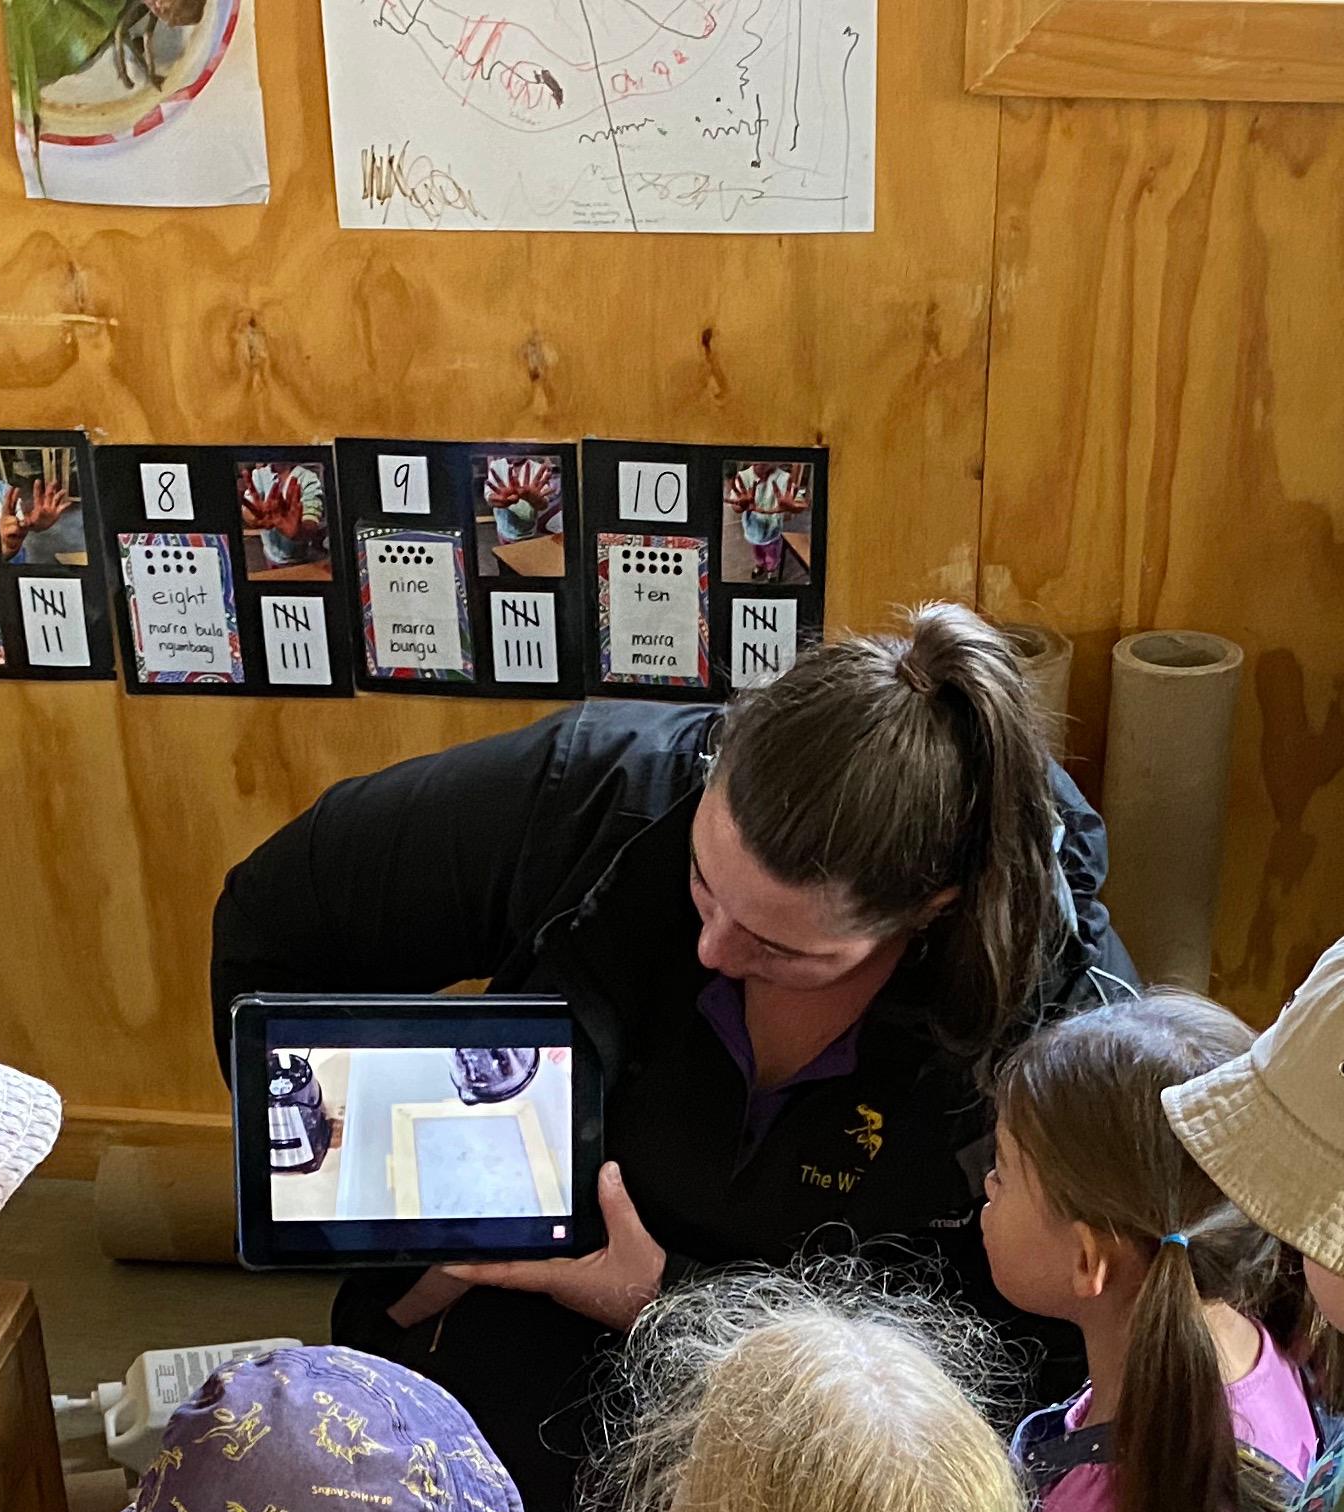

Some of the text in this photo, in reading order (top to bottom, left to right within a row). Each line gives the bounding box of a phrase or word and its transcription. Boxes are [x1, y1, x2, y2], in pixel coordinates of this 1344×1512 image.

[158, 471, 176, 512] 8
[394, 464, 410, 506] 9
[633, 469, 681, 515] 10
[390, 577, 429, 593] nine
[634, 582, 670, 602] ten
[152, 585, 208, 615] eight
[148, 622, 223, 637] marra bula
[392, 623, 435, 635] marra
[390, 639, 437, 661] bungu
[631, 634, 674, 648] marra
[631, 653, 678, 666] marra
[800, 1165, 833, 1189] The
